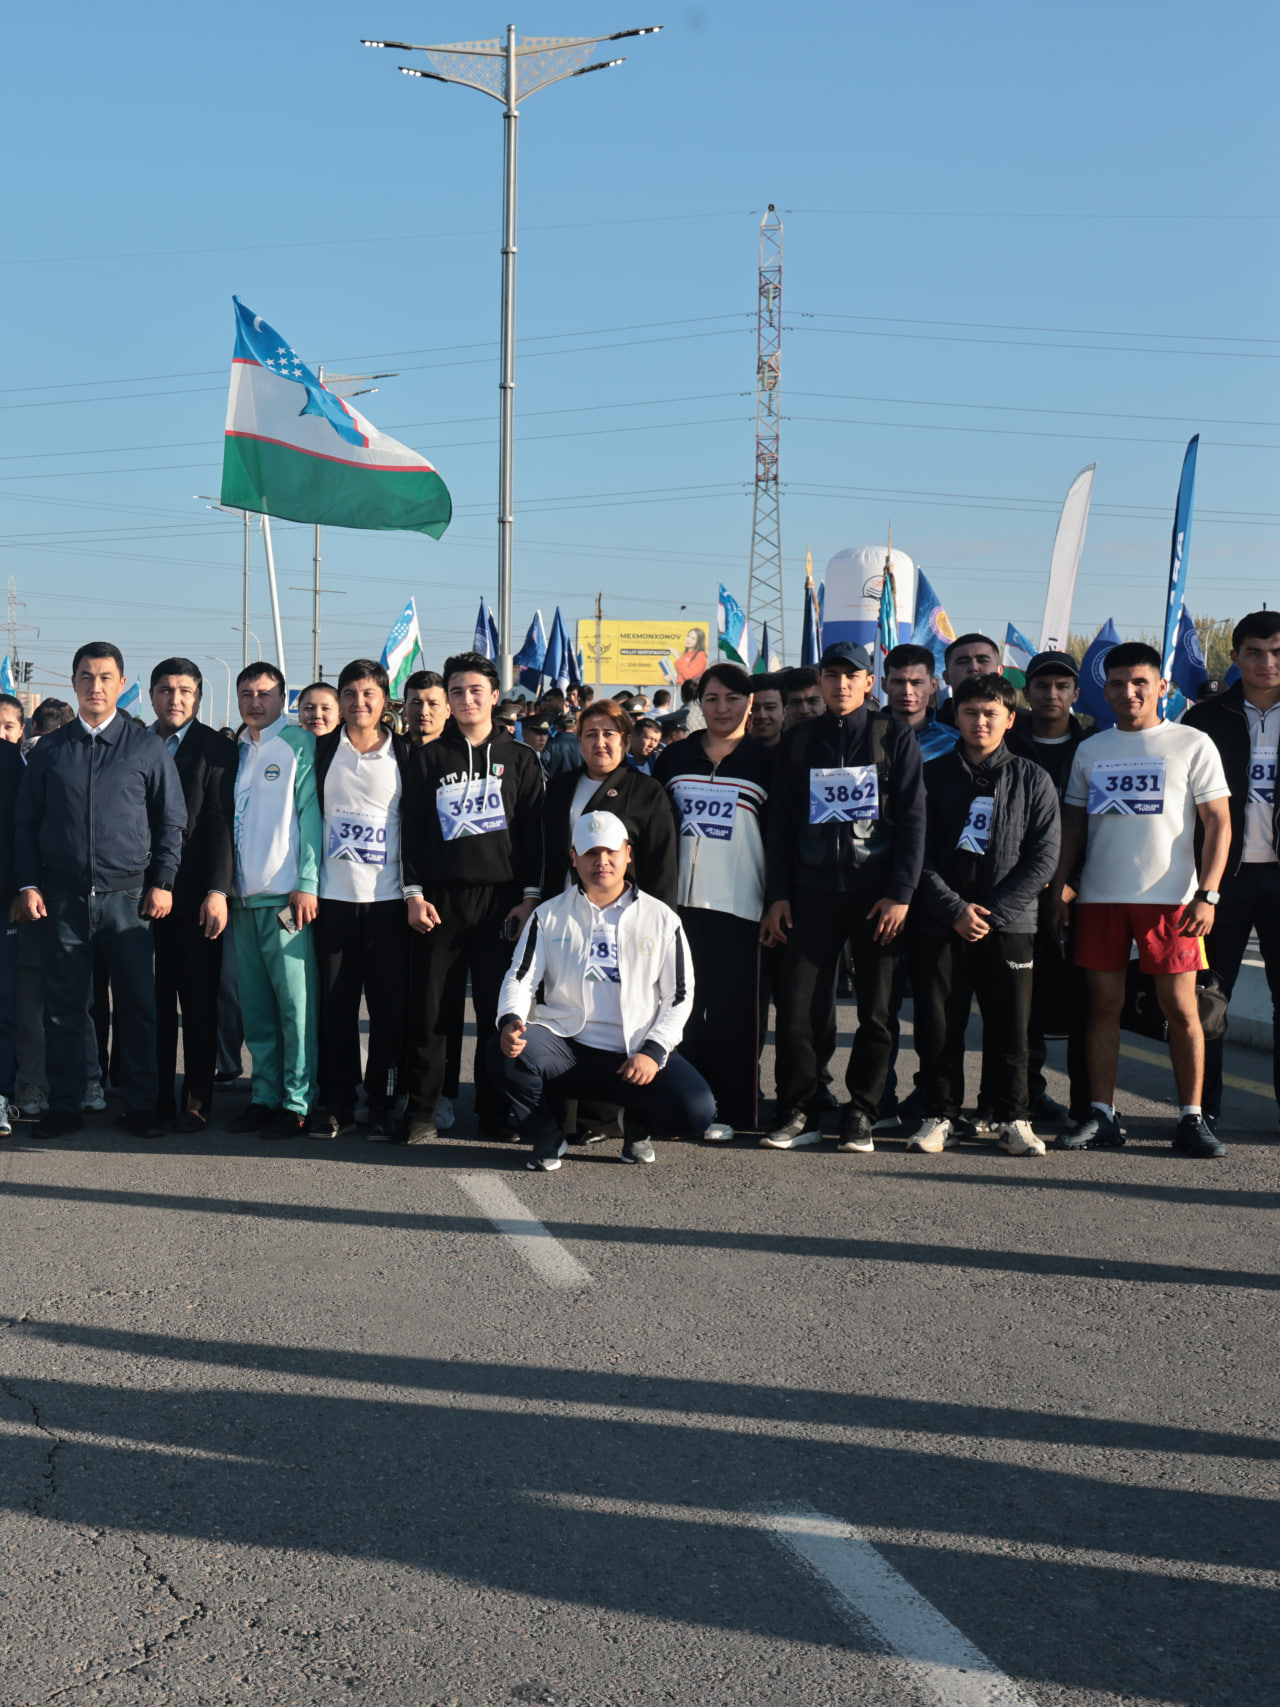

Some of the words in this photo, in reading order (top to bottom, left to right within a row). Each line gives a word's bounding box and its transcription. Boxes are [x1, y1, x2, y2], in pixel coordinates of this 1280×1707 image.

[824, 782, 876, 803] 3862
[1105, 775, 1160, 791] 3831
[449, 793, 500, 816] 3950
[683, 799, 733, 818] 3902
[340, 823, 386, 843] 3920
